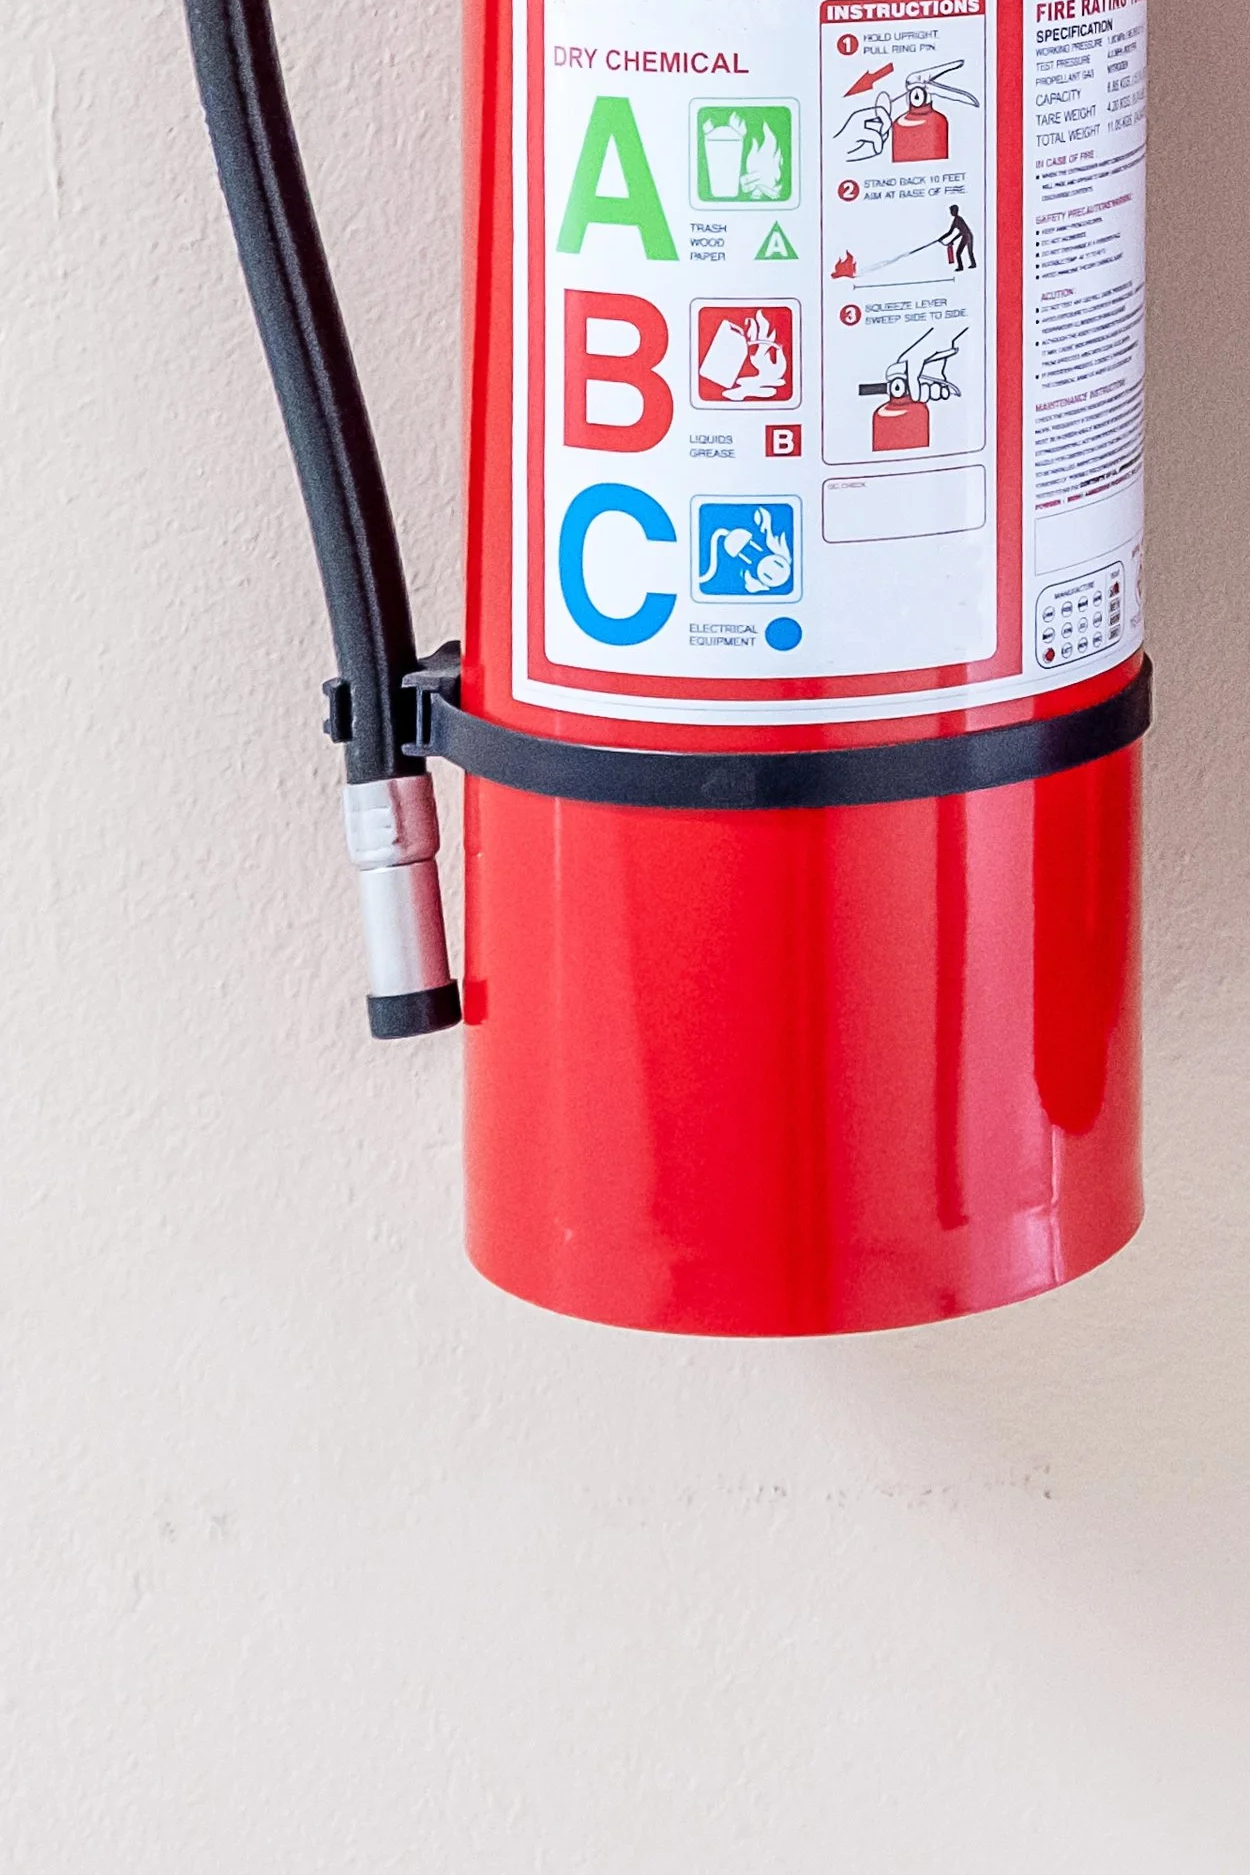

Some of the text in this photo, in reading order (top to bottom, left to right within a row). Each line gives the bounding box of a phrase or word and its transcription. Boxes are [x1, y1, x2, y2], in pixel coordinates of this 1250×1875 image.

[1036, 0, 1076, 23] FIRE
[863, 32, 892, 43] HOLD
[1036, 18, 1113, 43] SPECIFICATION
[863, 45, 888, 55] PULL
[891, 45, 916, 54] RING
[554, 45, 749, 74] DRY CHEMICAL
[1036, 88, 1081, 107] CAPACITY
[1036, 111, 1061, 126] TARE
[1063, 104, 1096, 122] WEIGHT
[1036, 132, 1066, 147] TOTAL
[1068, 124, 1101, 142] WEIGHT
[556, 96, 679, 261] A
[863, 178, 897, 189] STAND
[899, 177, 926, 187] BACK
[930, 175, 940, 184] 10
[942, 172, 967, 183] FEET
[863, 191, 882, 201] AIM
[884, 190, 896, 199] AT
[899, 189, 925, 199] BASE
[928, 187, 941, 196] OF
[690, 223, 727, 233] TRASH
[690, 237, 725, 247] WOOD
[764, 231, 789, 258] A
[690, 251, 726, 261] PAPER
[865, 300, 912, 312] SQUEEZE
[915, 298, 948, 308] LEVER
[865, 315, 901, 325] SWEEP
[905, 312, 927, 323] SIDE
[930, 311, 942, 320] TO
[564, 288, 674, 453] B
[690, 435, 733, 444] LIQUIDS
[773, 429, 794, 455] B
[690, 449, 736, 458] GREASE
[559, 482, 678, 646] C
[689, 623, 758, 634] ELECTRICAL
[689, 636, 756, 646] EQUIPMENT
